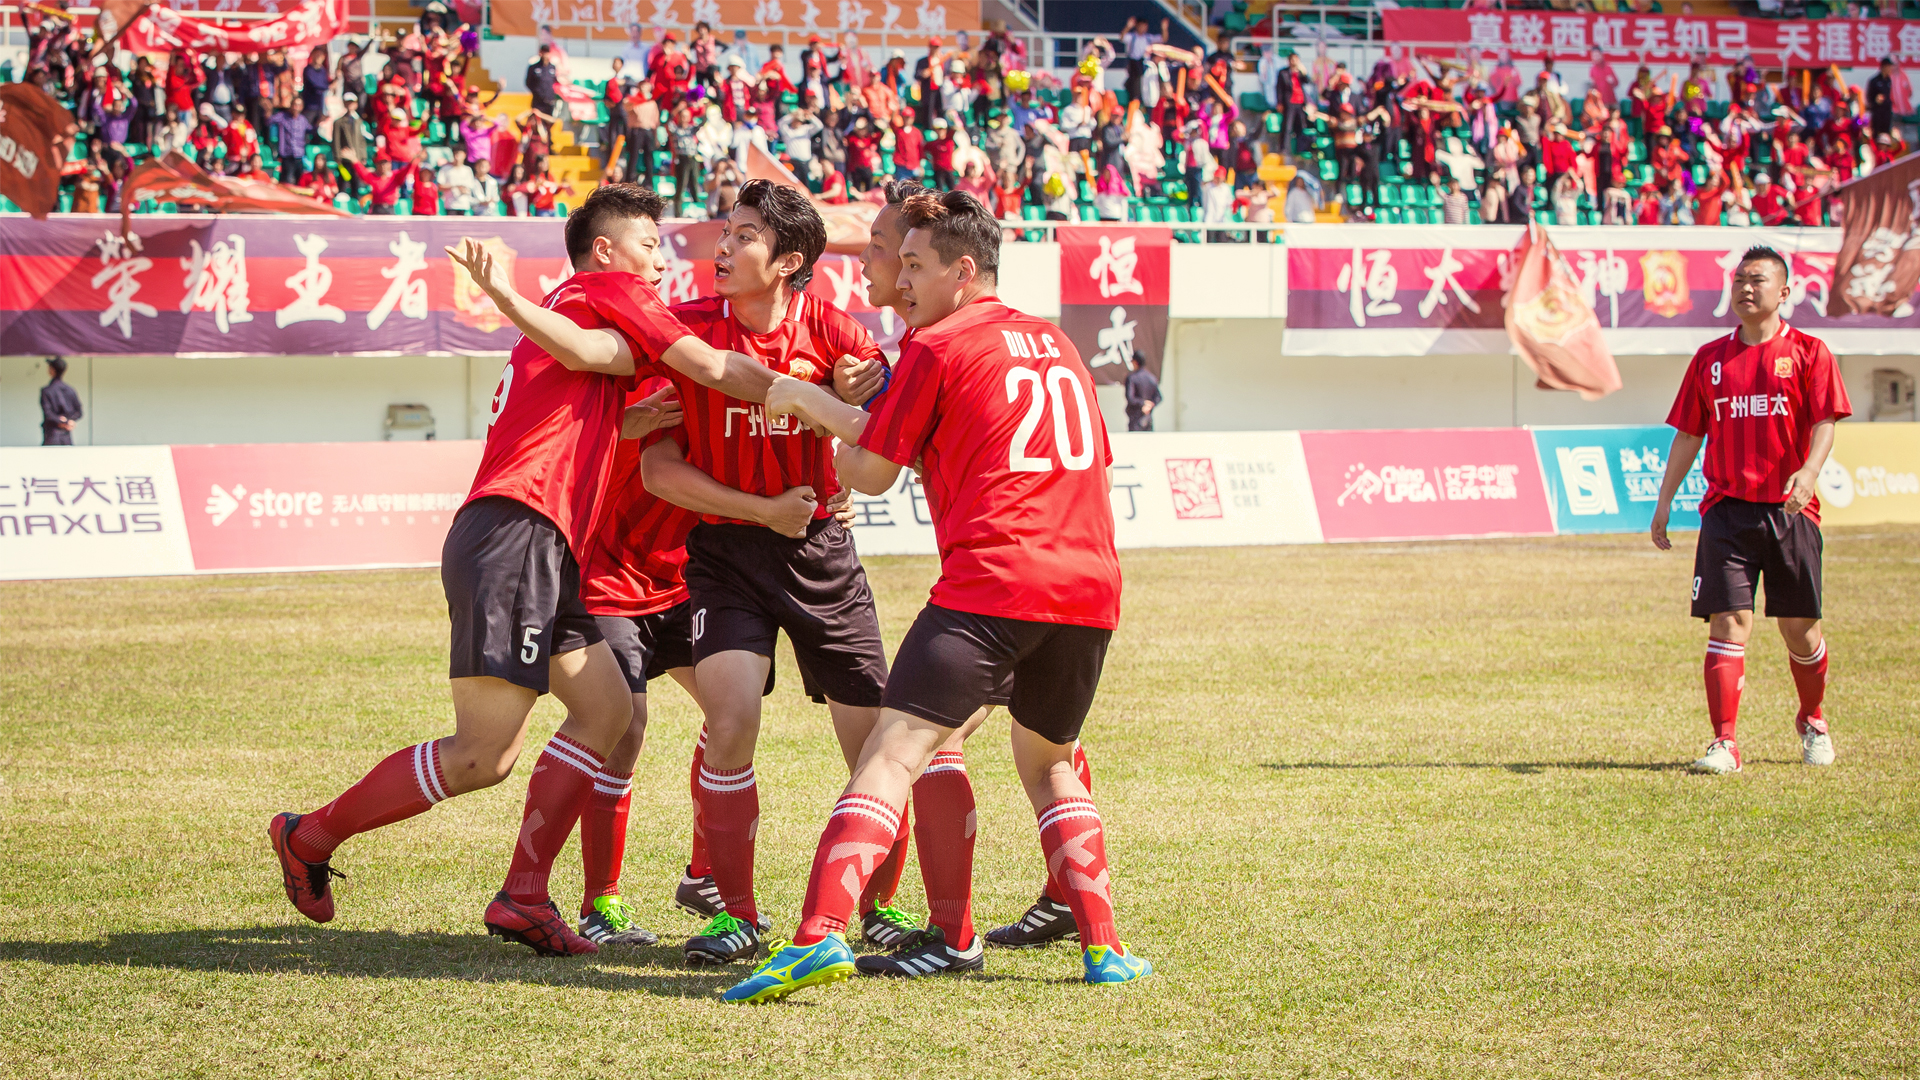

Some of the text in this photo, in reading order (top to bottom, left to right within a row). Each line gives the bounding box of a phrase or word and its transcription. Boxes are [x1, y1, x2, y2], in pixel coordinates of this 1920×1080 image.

[1469, 14, 1749, 60] 莫愁西虹无知己
[91, 229, 429, 339] 荣耀王者
[1001, 330, 1031, 358] DU
[1710, 361, 1722, 386] 9
[1005, 365, 1094, 472] 20
[1713, 393, 1788, 422] 广州恒太
[1226, 462, 1276, 474] HUANG
[1381, 465, 1425, 484] China
[249, 488, 324, 517] store
[1384, 483, 1437, 503] LPGA
[1692, 575, 1702, 601] 9
[520, 627, 542, 665] 5
